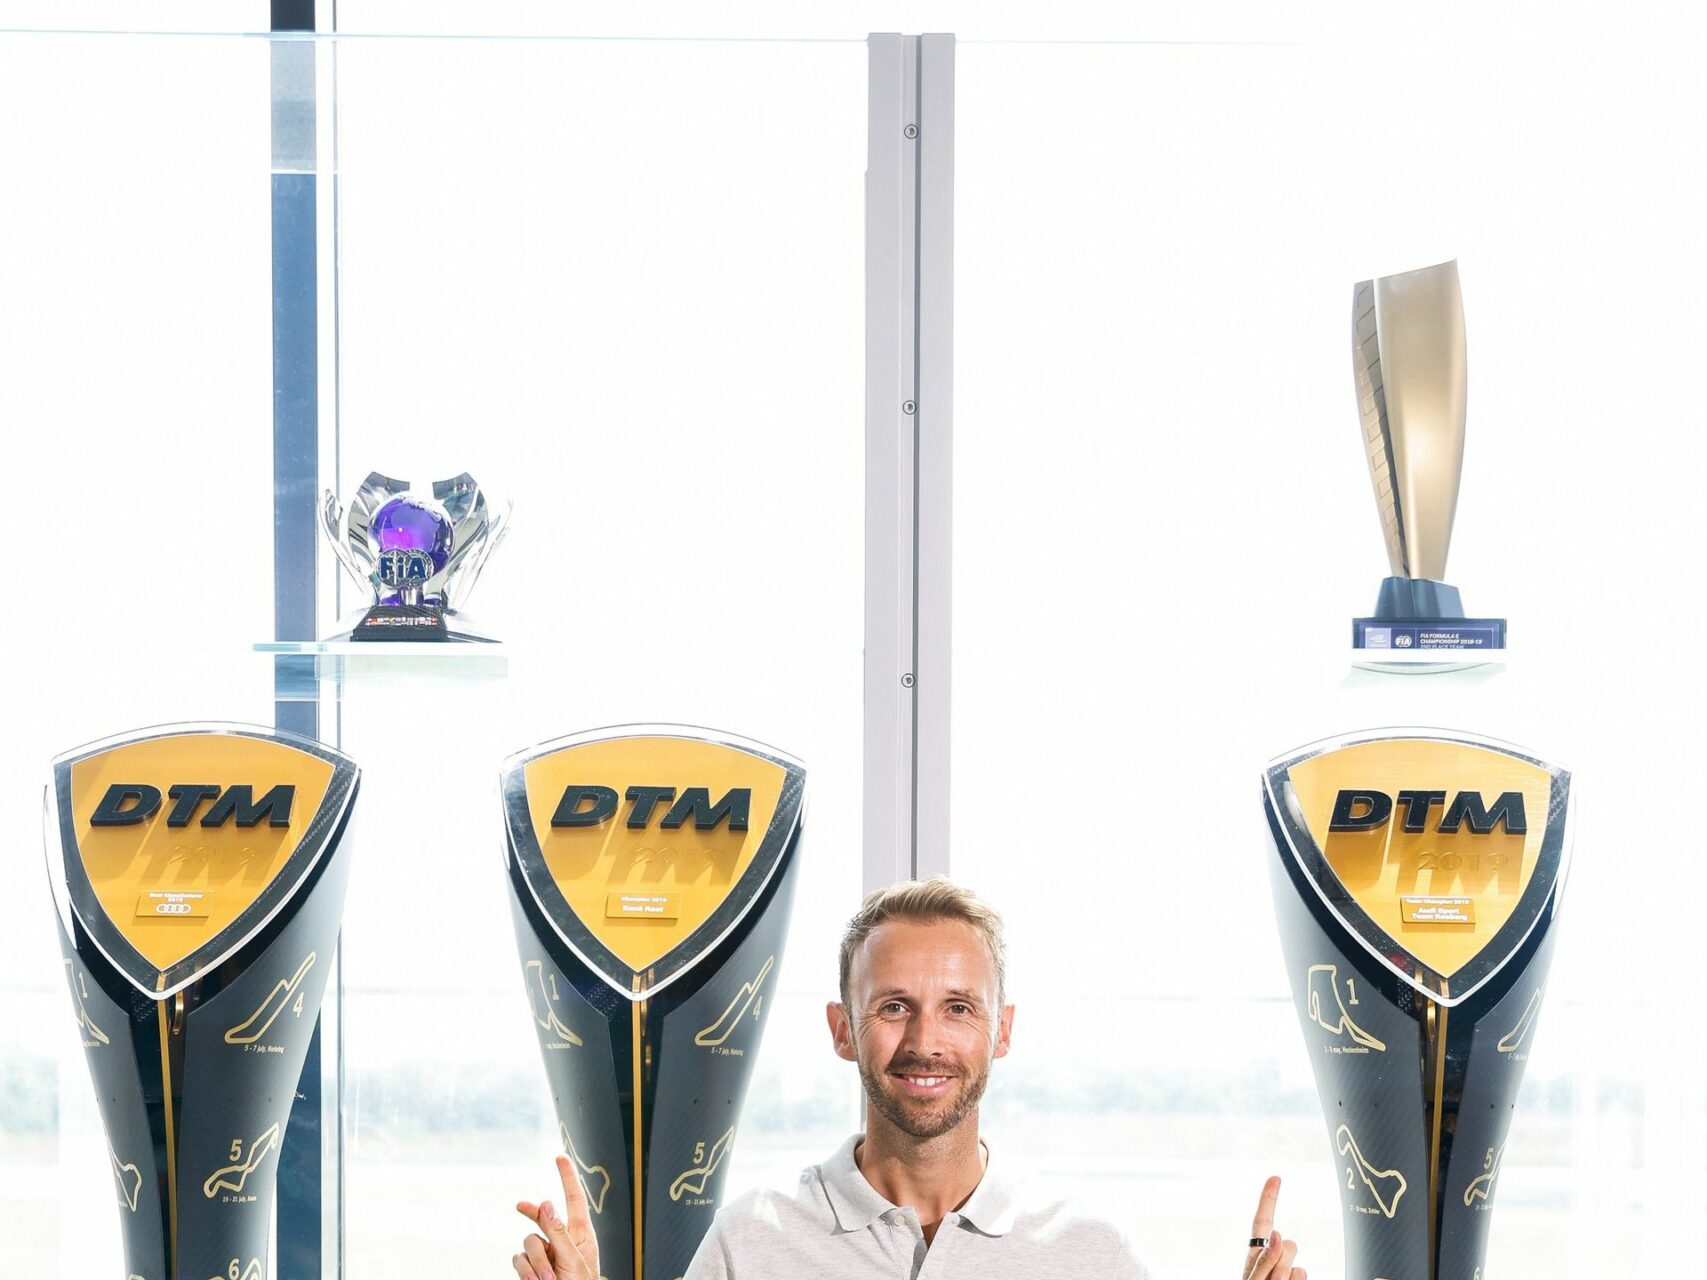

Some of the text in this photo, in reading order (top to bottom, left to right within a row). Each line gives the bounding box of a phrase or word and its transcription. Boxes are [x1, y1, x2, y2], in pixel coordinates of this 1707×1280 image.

[90, 783, 297, 828] DTM
[550, 785, 752, 831] DTM
[1328, 789, 1528, 835] DTM
[79, 972, 88, 998] 1
[549, 974, 559, 1000] 1
[1346, 979, 1359, 1005] 1
[293, 992, 304, 1018] 4
[753, 995, 763, 1021] 4
[229, 1139, 243, 1161] 5
[693, 1142, 705, 1164] 5
[1484, 1147, 1494, 1169] 5
[1346, 1167, 1355, 1190] 2
[229, 1258, 240, 1280] 6
